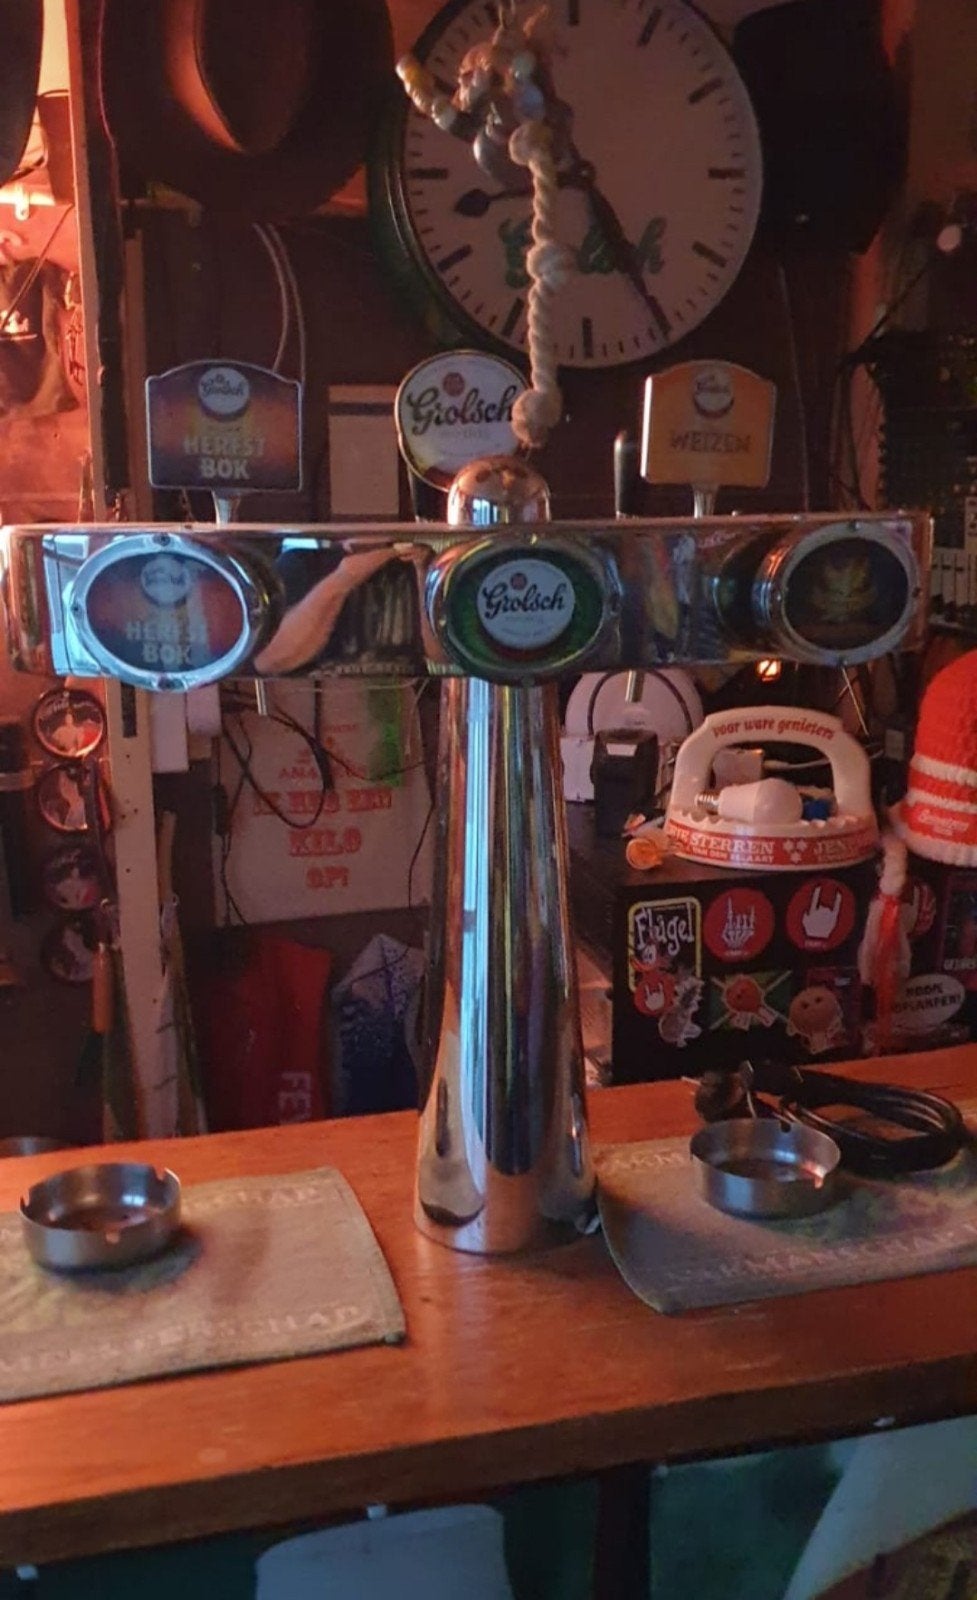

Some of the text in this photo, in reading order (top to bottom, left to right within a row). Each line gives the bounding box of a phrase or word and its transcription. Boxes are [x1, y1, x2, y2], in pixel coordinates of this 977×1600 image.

[406, 385, 517, 435] Grolsch
[201, 458, 250, 480] BOK
[481, 582, 567, 620] Grolsch
[690, 831, 775, 855] STERREN
